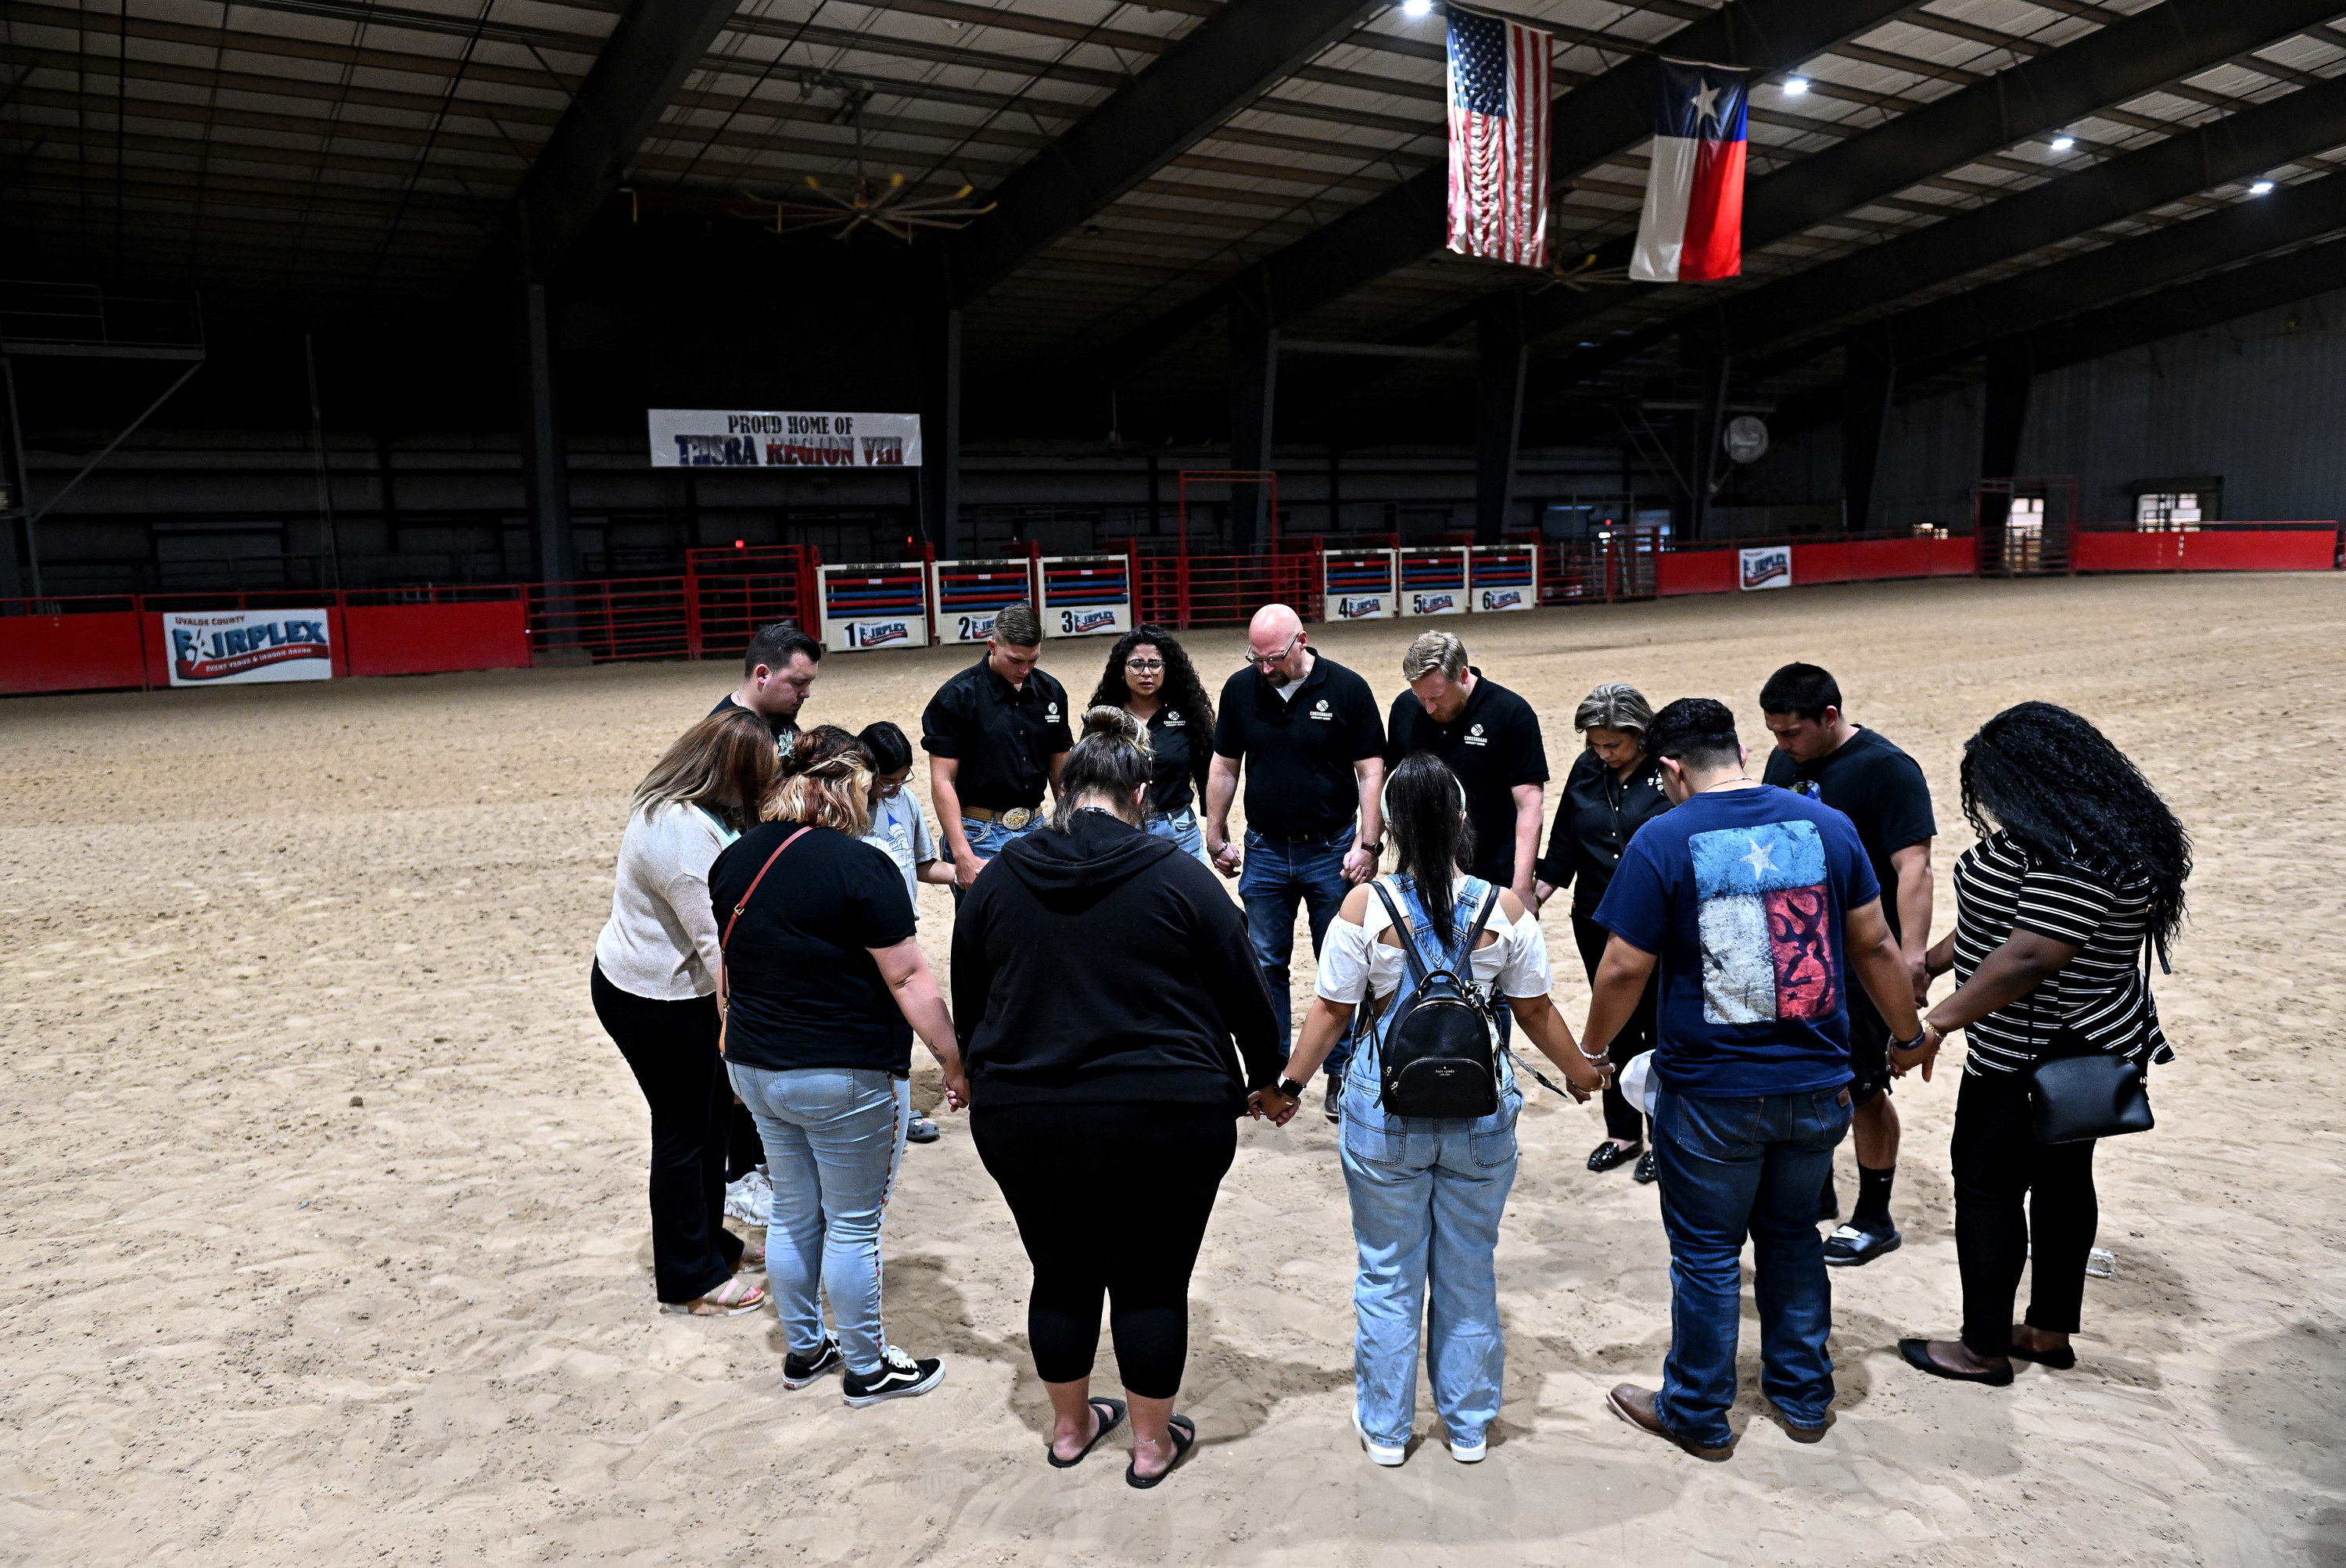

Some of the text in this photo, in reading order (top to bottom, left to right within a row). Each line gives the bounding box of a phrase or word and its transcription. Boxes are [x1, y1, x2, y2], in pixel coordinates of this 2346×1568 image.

[727, 414, 853, 435] PROUD HOME OF
[766, 435, 854, 465] REGION
[1338, 597, 1348, 618] 4
[1413, 594, 1422, 614] 5
[1483, 590, 1490, 610] 6
[211, 615, 245, 626] COUNTY
[958, 616, 970, 640] 2
[1060, 611, 1074, 633] 3
[845, 623, 856, 647] 1
